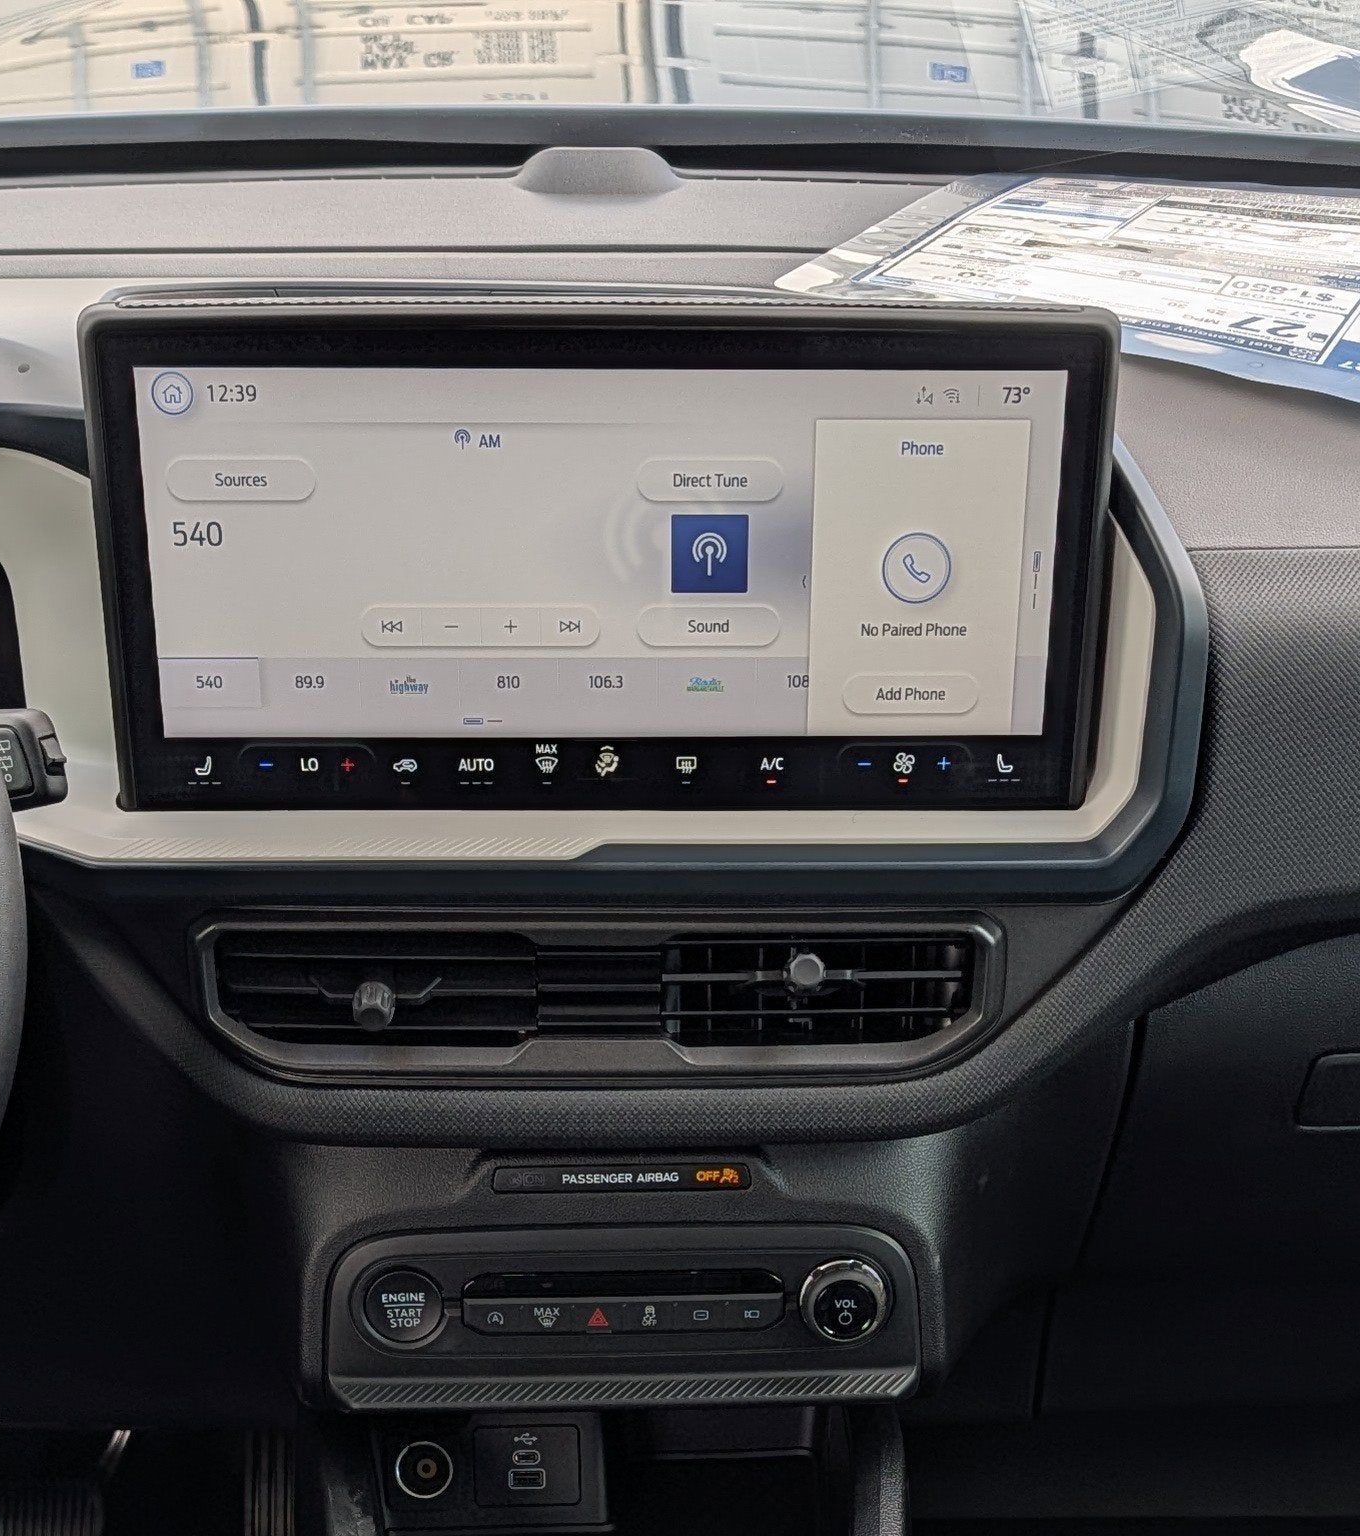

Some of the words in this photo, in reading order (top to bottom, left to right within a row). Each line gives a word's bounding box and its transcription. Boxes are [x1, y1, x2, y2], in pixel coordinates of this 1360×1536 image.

[1231, 281, 1334, 302] $1,850
[1228, 315, 1308, 338] 27
[1174, 325, 1244, 347] Economy
[1249, 340, 1282, 352] Fuel
[207, 384, 257, 402] 12:39
[478, 434, 501, 448] AM
[900, 441, 944, 456] Phone
[214, 472, 268, 488] Sources
[673, 473, 712, 488] Direct
[714, 473, 748, 488] Tune
[172, 521, 224, 547] 540
[687, 619, 730, 634] Sound
[860, 623, 879, 637] No
[881, 622, 924, 637] Paired
[926, 622, 968, 637] Phone
[196, 676, 223, 690] 540
[294, 676, 325, 690] 89.9
[390, 680, 429, 694] highway
[496, 676, 521, 689] 810
[588, 675, 624, 690] 106.3
[876, 687, 901, 702] Add
[904, 687, 946, 702] Phone
[534, 744, 558, 754] MAX
[300, 758, 320, 772] LO
[458, 758, 494, 772] AUTO
[760, 756, 784, 772] A/C
[562, 1174, 632, 1184] PASSENGER
[636, 1172, 680, 1182] AIRBAG
[696, 1170, 720, 1182] OFF
[382, 1292, 426, 1303] ENGINE
[834, 1299, 858, 1309] VOL
[386, 1308, 423, 1318] START
[534, 1306, 560, 1317] MAX
[390, 1318, 421, 1328] STOP
[642, 1319, 658, 1327] OFF
